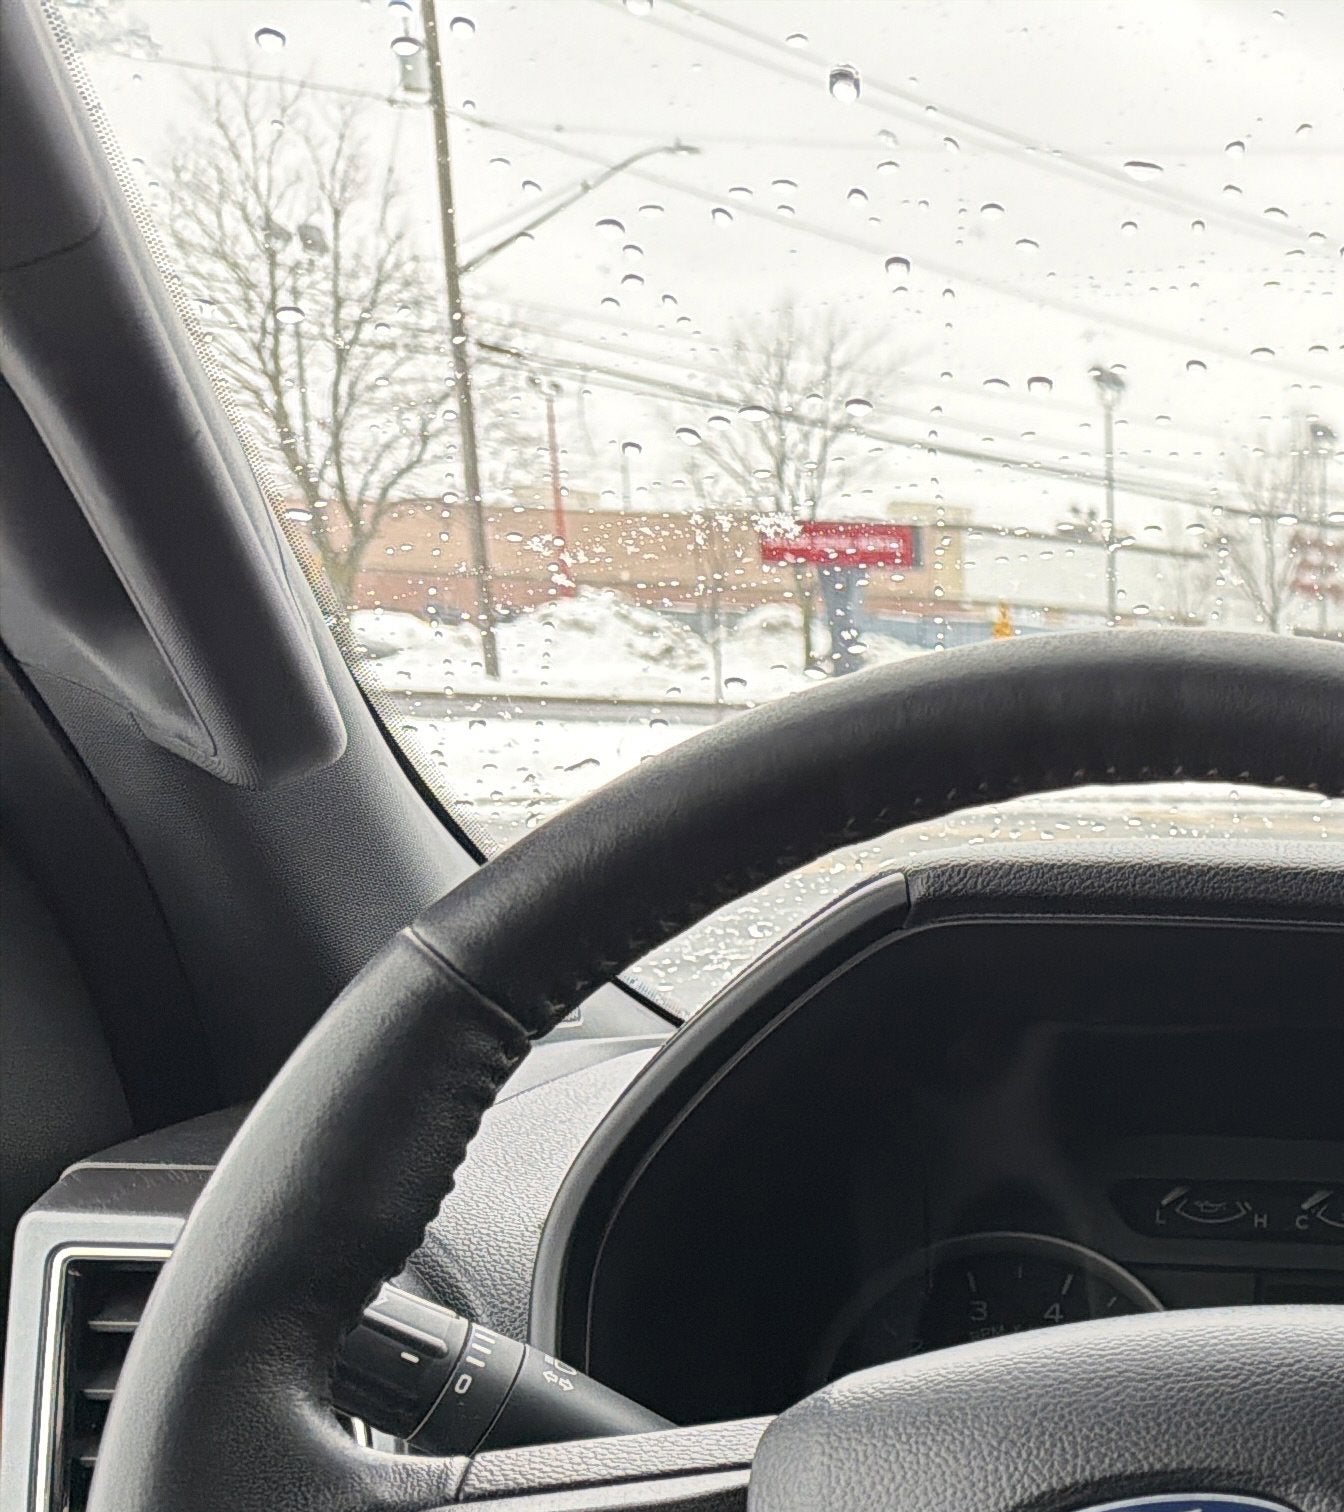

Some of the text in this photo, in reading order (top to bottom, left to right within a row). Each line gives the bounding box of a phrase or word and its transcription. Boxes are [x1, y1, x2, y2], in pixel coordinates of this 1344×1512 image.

[1253, 1213, 1268, 1228] H
[1295, 1214, 1309, 1230] C
[968, 1300, 989, 1321] 3
[1043, 1302, 1064, 1323] 4
